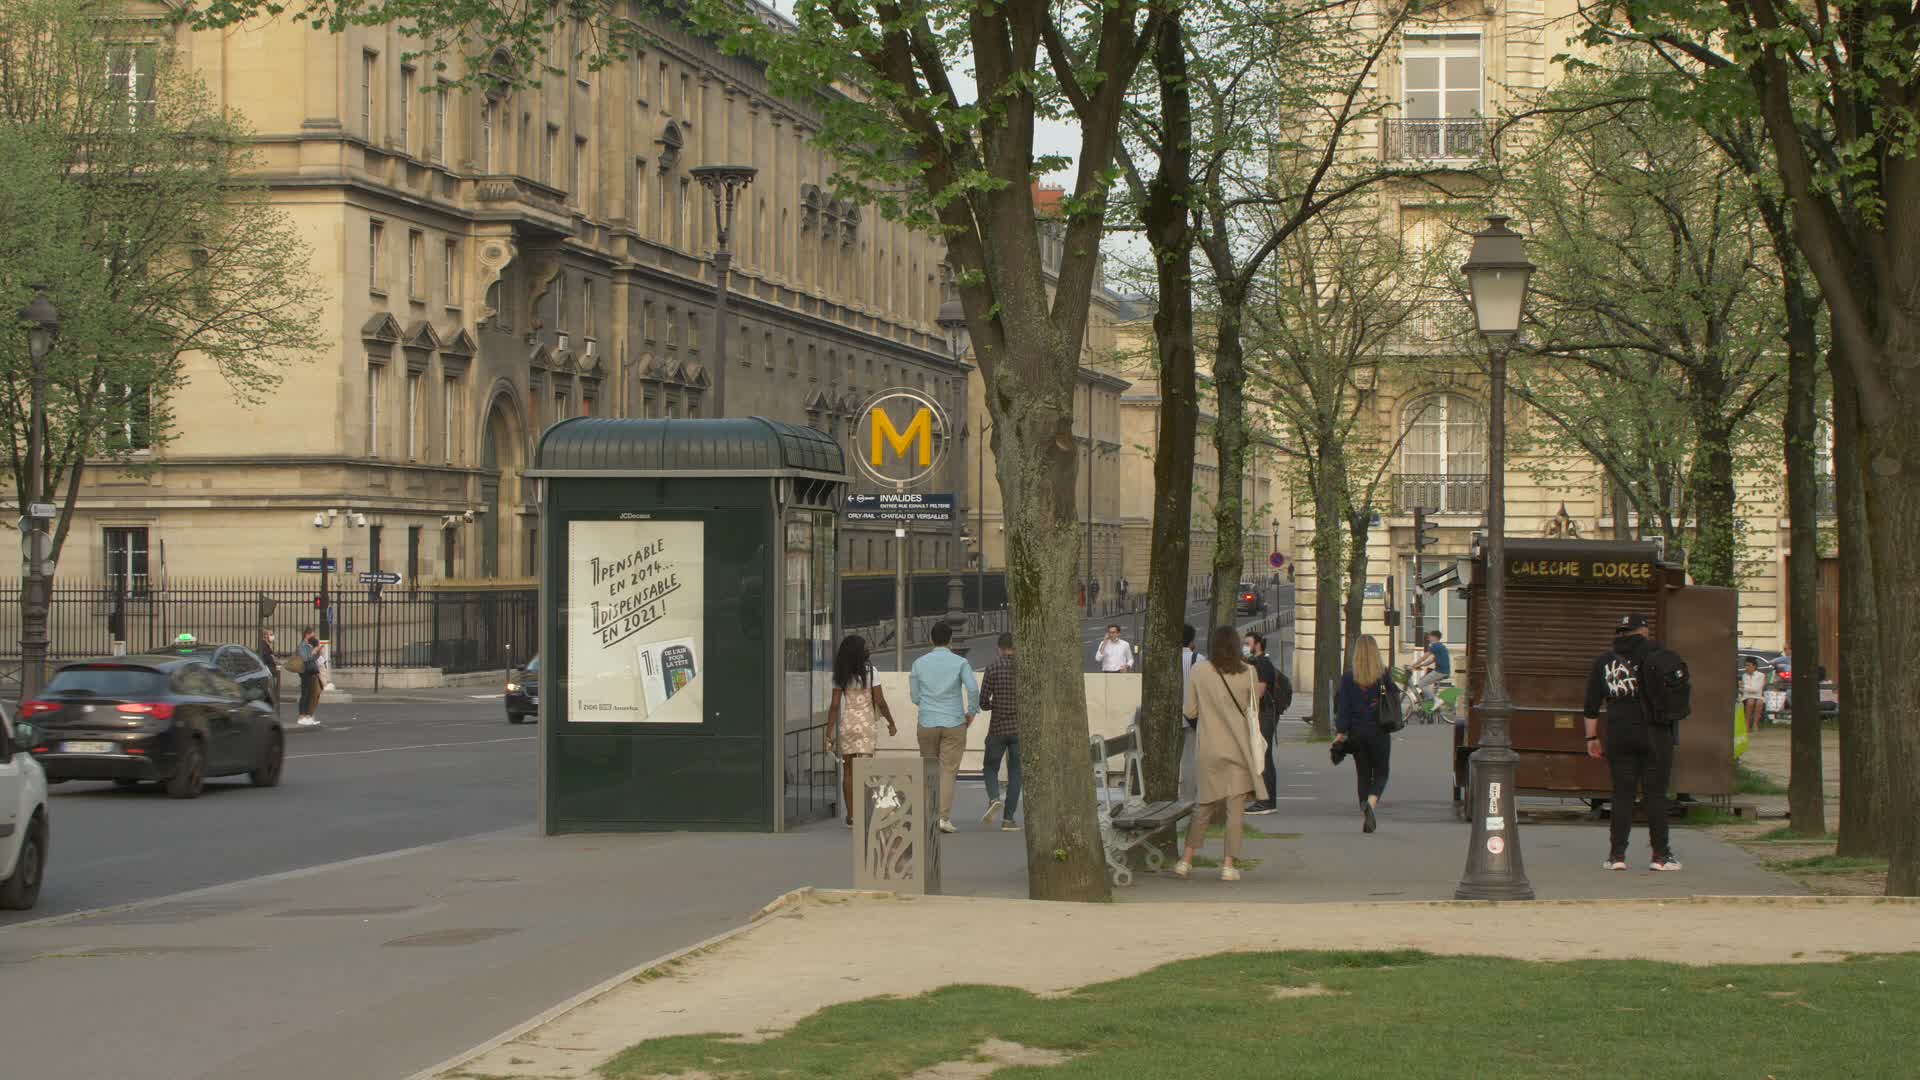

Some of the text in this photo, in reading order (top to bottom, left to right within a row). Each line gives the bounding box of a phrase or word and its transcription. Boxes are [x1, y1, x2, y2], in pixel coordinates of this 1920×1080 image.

[871, 407, 931, 467] M
[880, 494, 922, 502] INVALIDES
[1511, 560, 1652, 578] CALECHE DOREE
[610, 579, 625, 596] EN
[602, 624, 618, 644] EN
[624, 605, 656, 633] 2021
